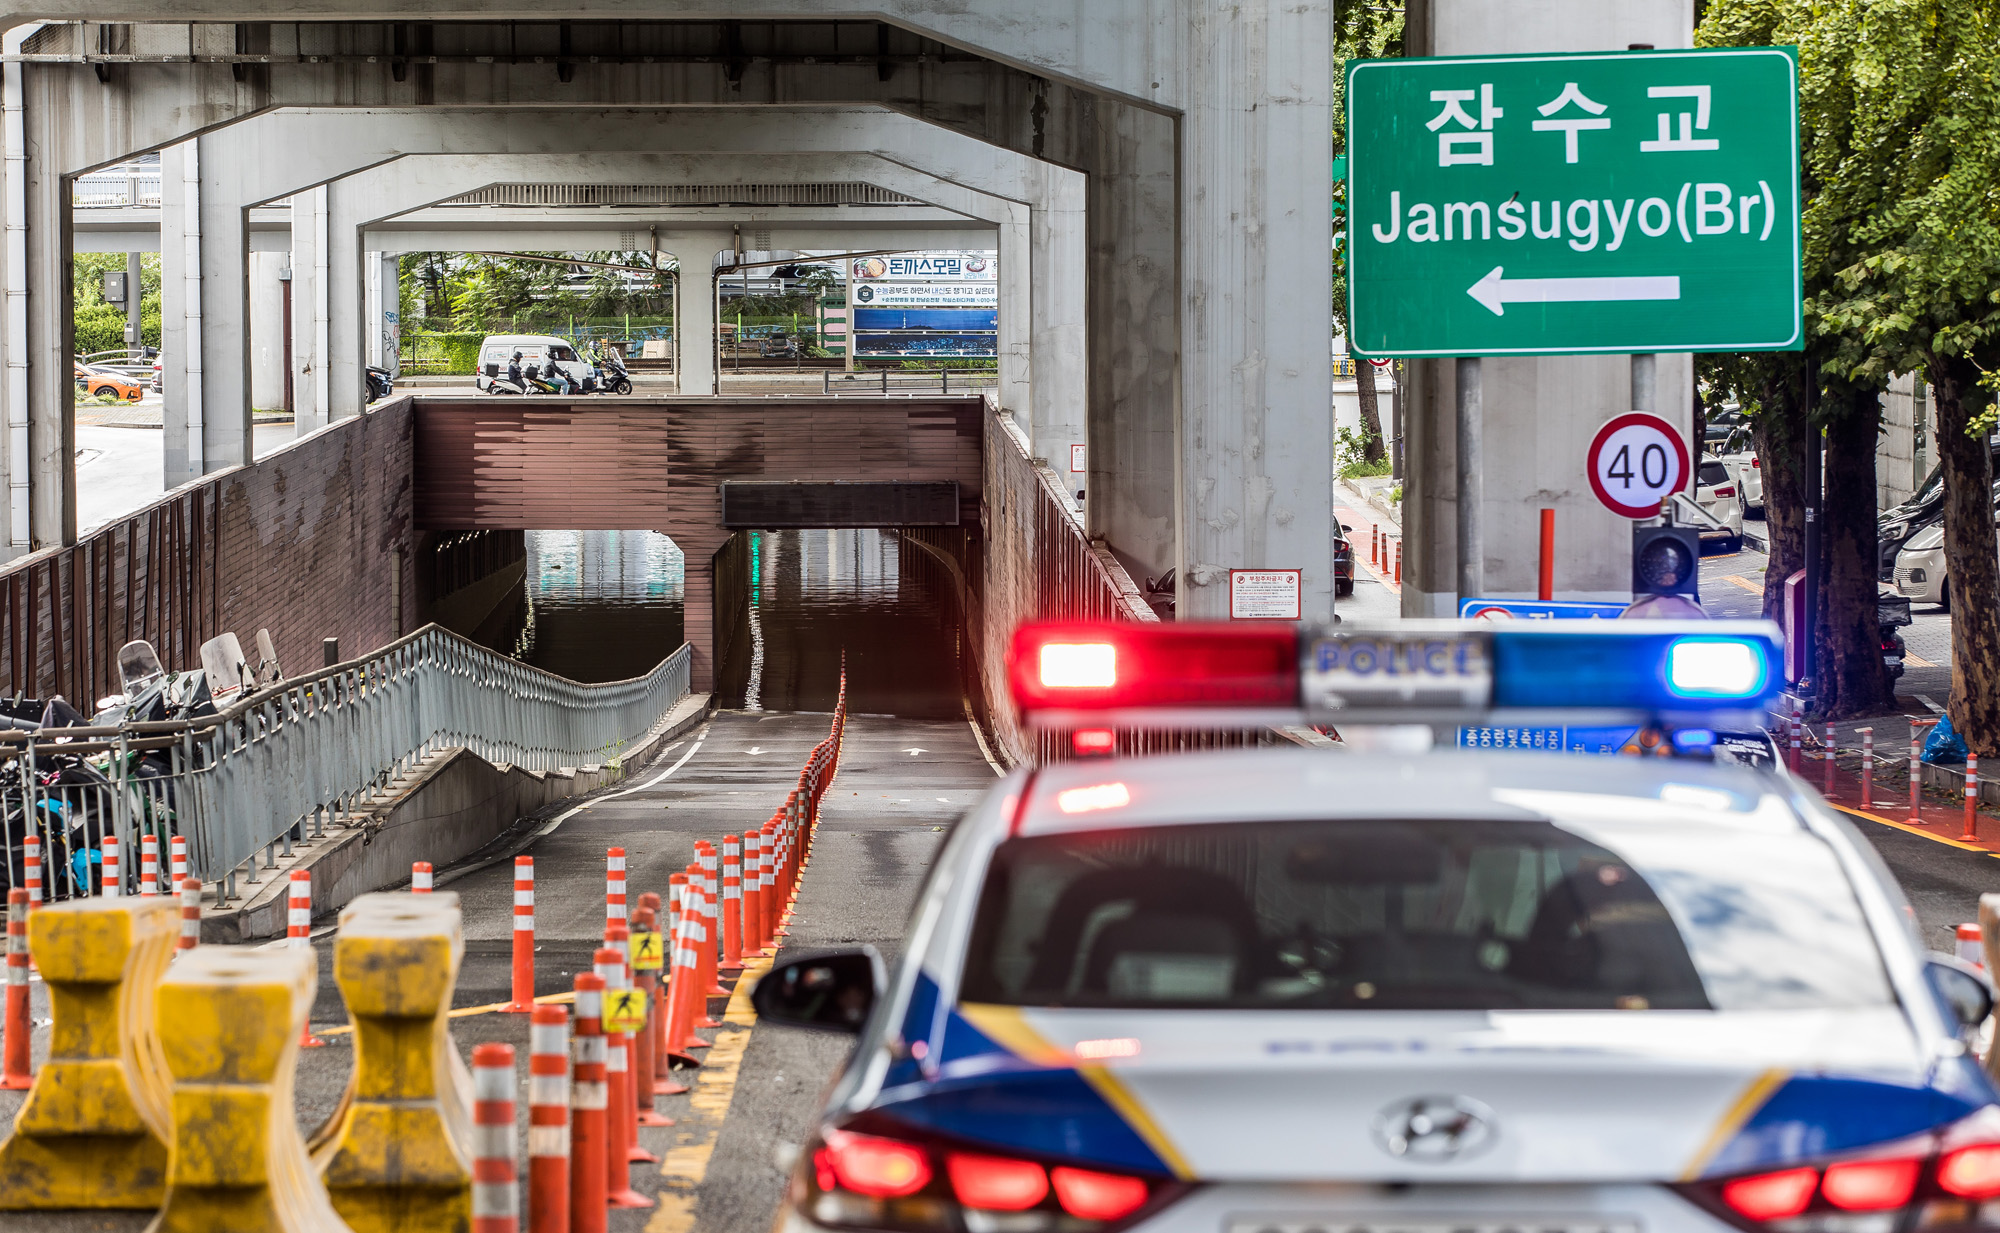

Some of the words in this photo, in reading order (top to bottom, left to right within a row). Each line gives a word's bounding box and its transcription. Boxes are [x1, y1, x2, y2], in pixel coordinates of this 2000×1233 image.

[1371, 180, 1775, 252] Jamsugyo(Br)
[889, 259, 961, 275] 돈까스모밀
[875, 287, 909, 295] 수능공부도
[975, 287, 995, 295] 싶은데
[1607, 443, 1667, 489] 40
[1316, 641, 1481, 677] POLICE
